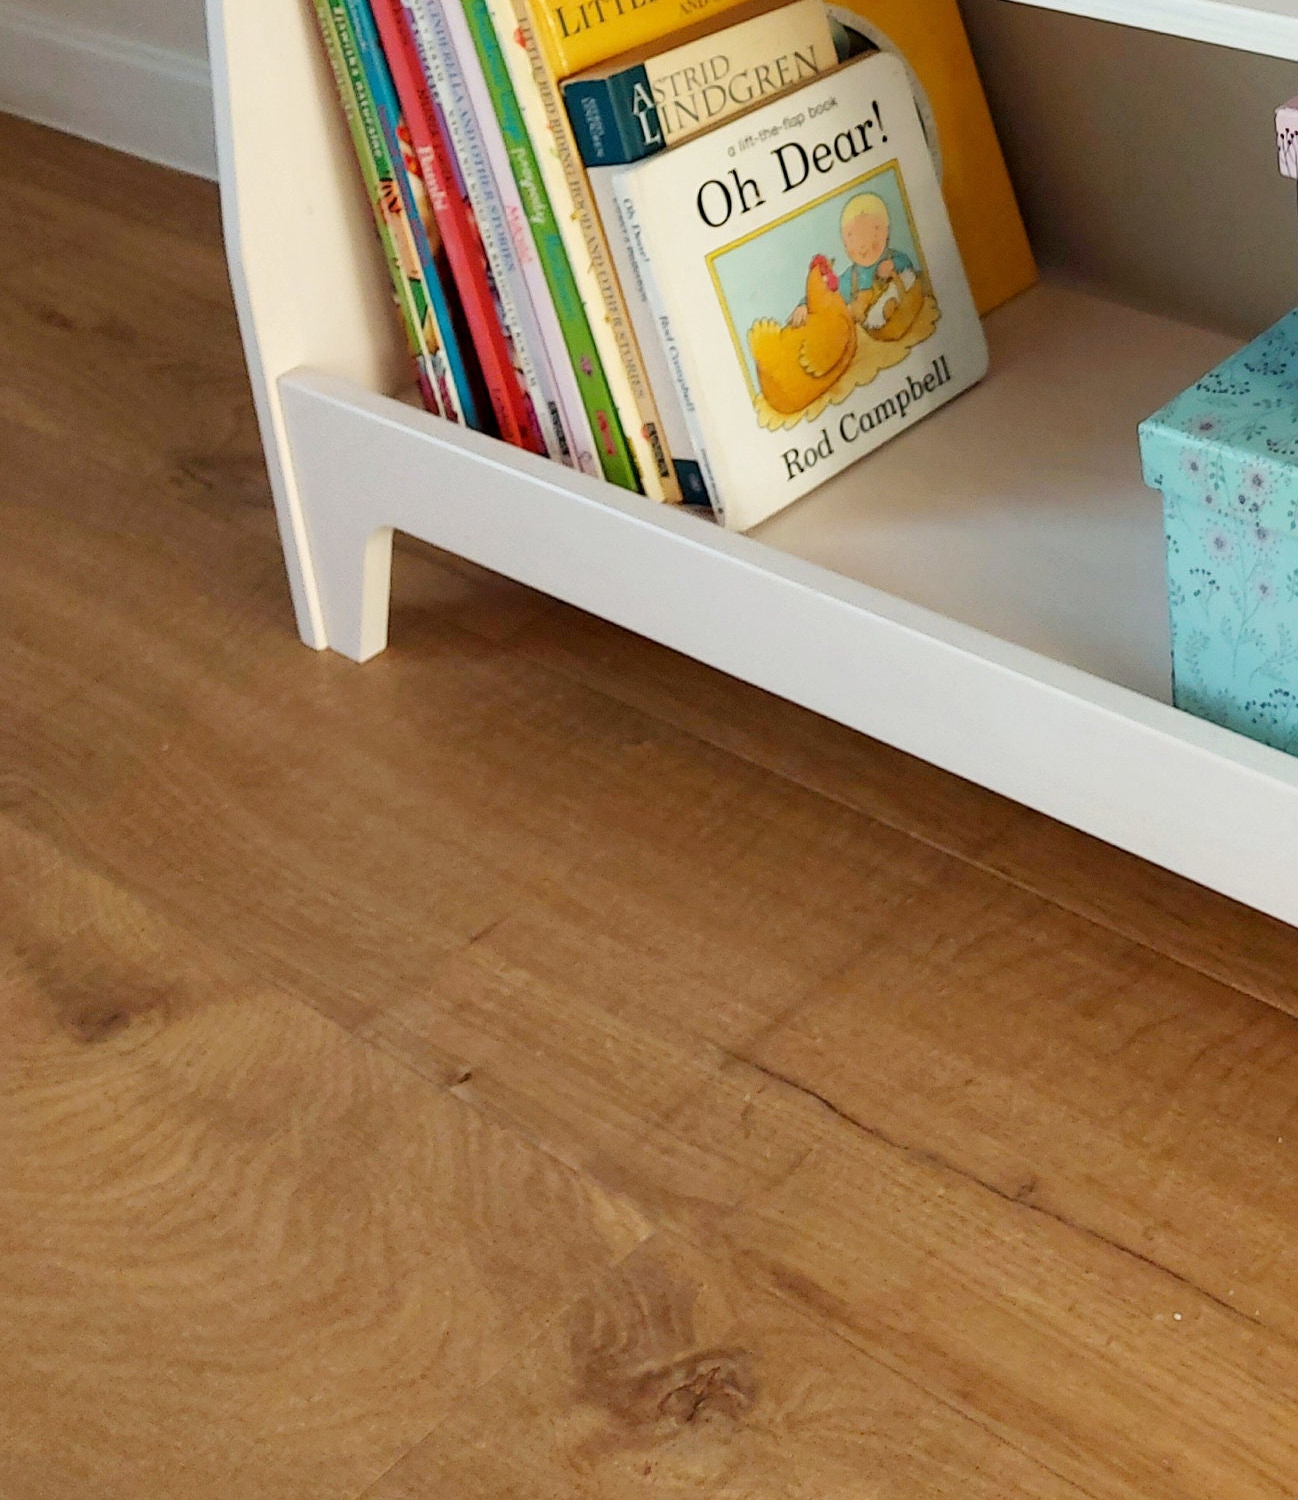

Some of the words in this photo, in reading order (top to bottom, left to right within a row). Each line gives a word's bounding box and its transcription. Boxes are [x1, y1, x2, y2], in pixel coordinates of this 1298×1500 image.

[631, 54, 730, 115] ASTRID
[636, 44, 820, 144] LINDGREN
[727, 146, 736, 158] a
[738, 112, 806, 152] lift-the-flap
[807, 96, 839, 119] book
[697, 168, 766, 227] Oh
[770, 100, 887, 194] Dear!
[781, 430, 834, 481] Rod
[839, 355, 951, 443] Campbell
